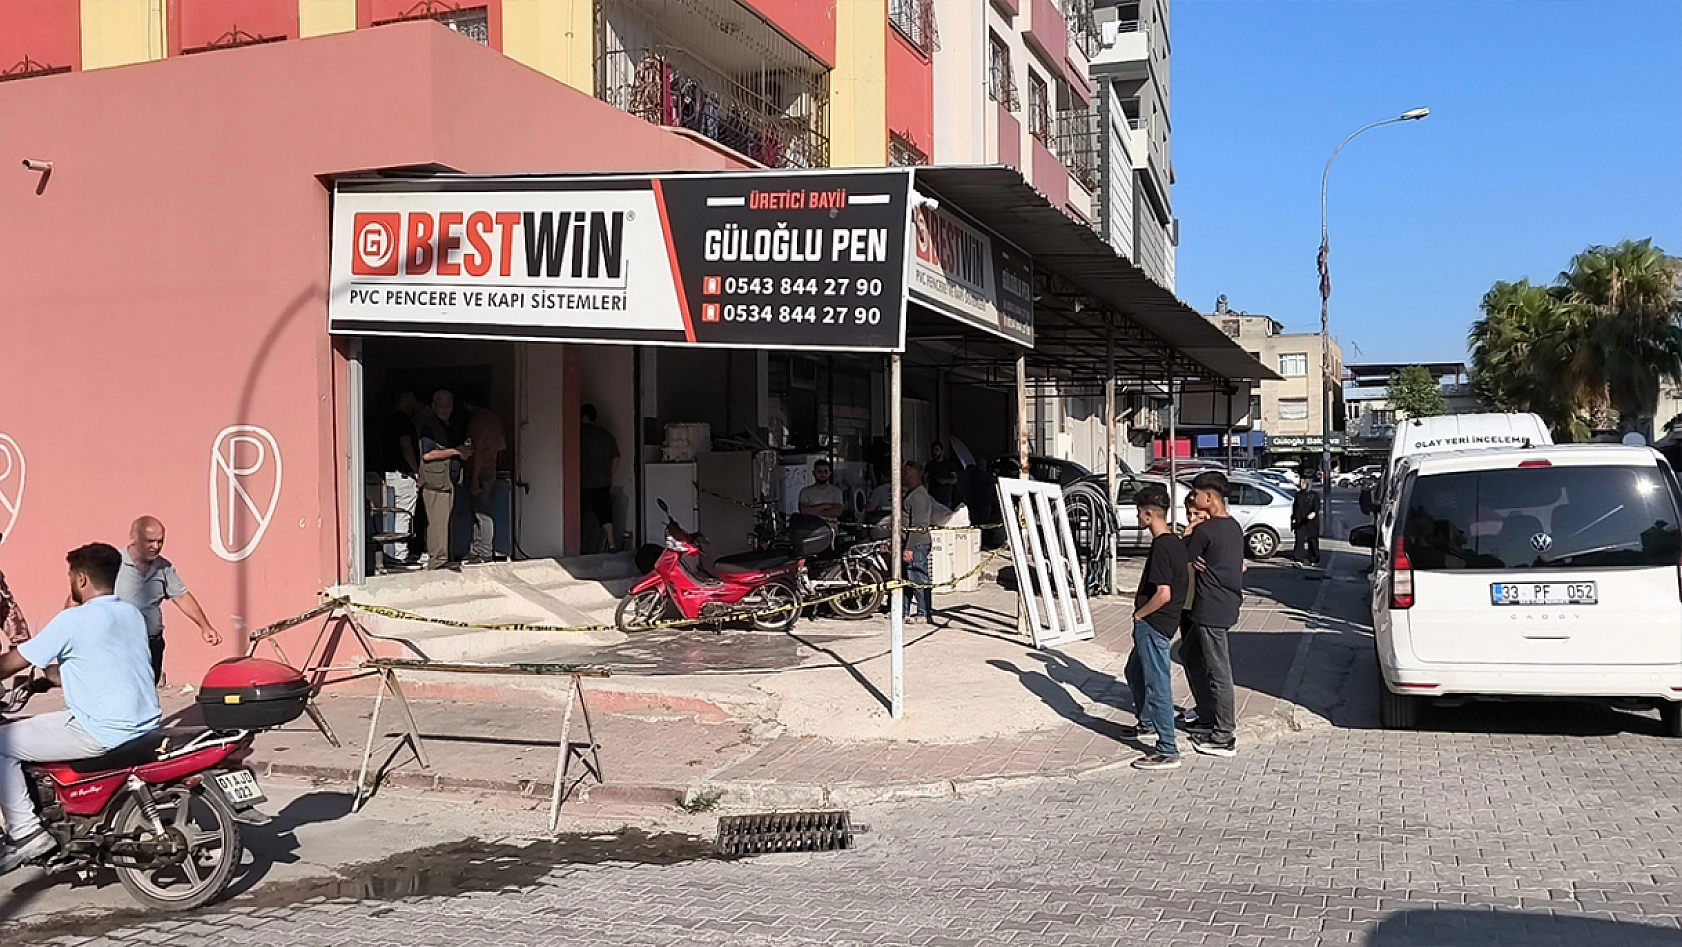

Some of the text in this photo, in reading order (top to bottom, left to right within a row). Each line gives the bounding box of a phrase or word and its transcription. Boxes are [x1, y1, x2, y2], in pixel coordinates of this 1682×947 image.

[749, 188, 846, 209] ÜRETİCİ BAYİİ
[704, 221, 888, 262] GÜLOĞLU PEN
[724, 277, 882, 296] 0543 844 27 90
[350, 289, 627, 312] PVC PENCERE VE KAPI SİSTEMLERİ
[723, 304, 881, 324] 0534 844 27 90
[1415, 439, 1442, 449] OLAY
[1502, 584, 1593, 599] 33 PF 052
